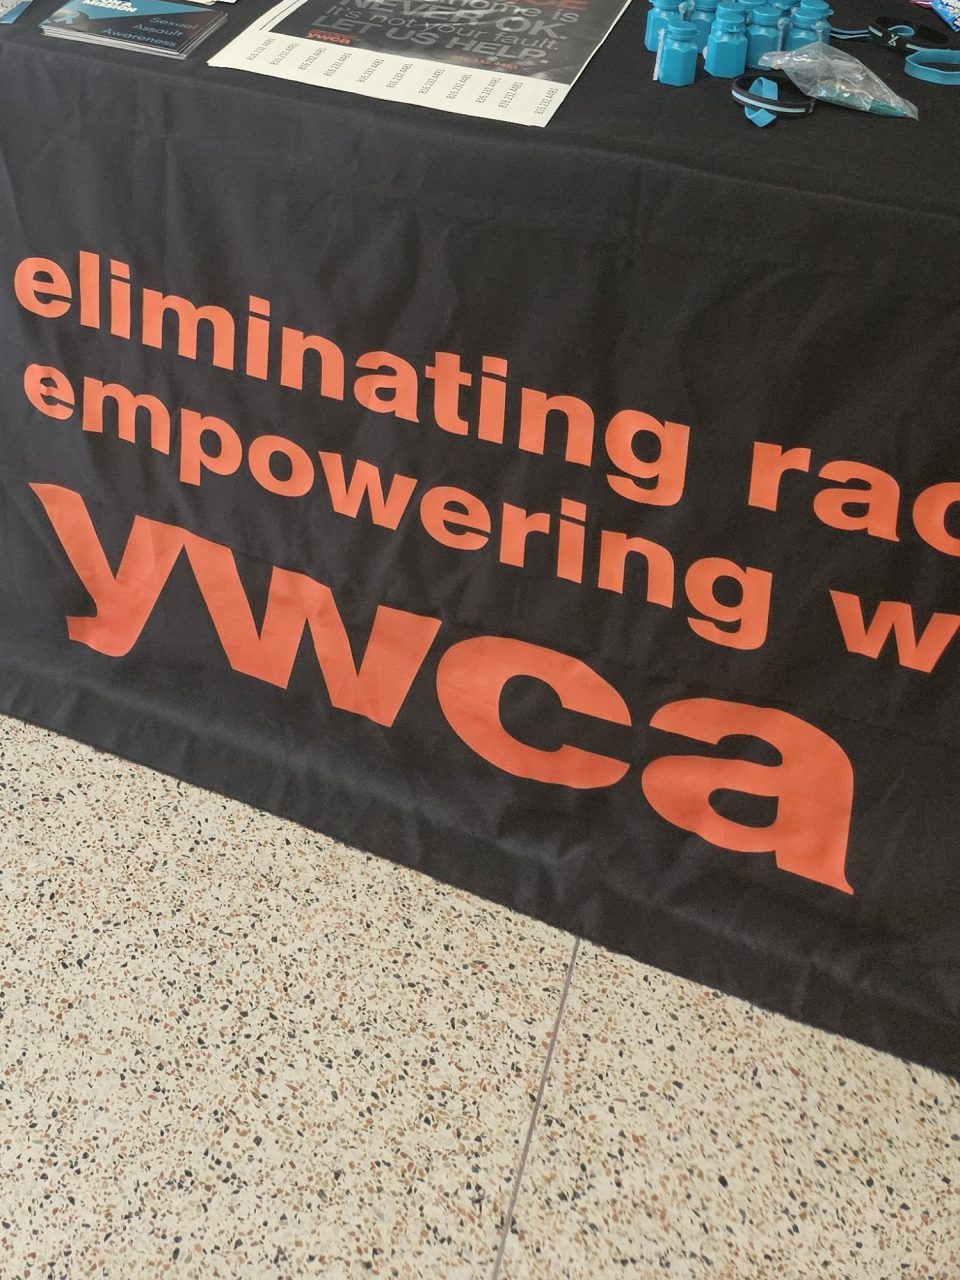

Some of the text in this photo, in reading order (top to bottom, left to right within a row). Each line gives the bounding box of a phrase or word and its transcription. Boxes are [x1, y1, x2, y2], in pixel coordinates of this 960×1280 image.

[131, 24, 183, 37] Assault
[149, 17, 199, 30] Sexual
[326, 4, 559, 51] It's not your fault.
[495, 16, 568, 40] OK.
[551, 8, 580, 23] is
[101, 28, 177, 48] Awareness
[311, 15, 383, 35] LET
[385, 27, 440, 46] US
[445, 36, 549, 65] HELP.
[13, 250, 692, 507] eliminating
[21, 362, 774, 651] empowering
[28, 480, 856, 896] ywca
